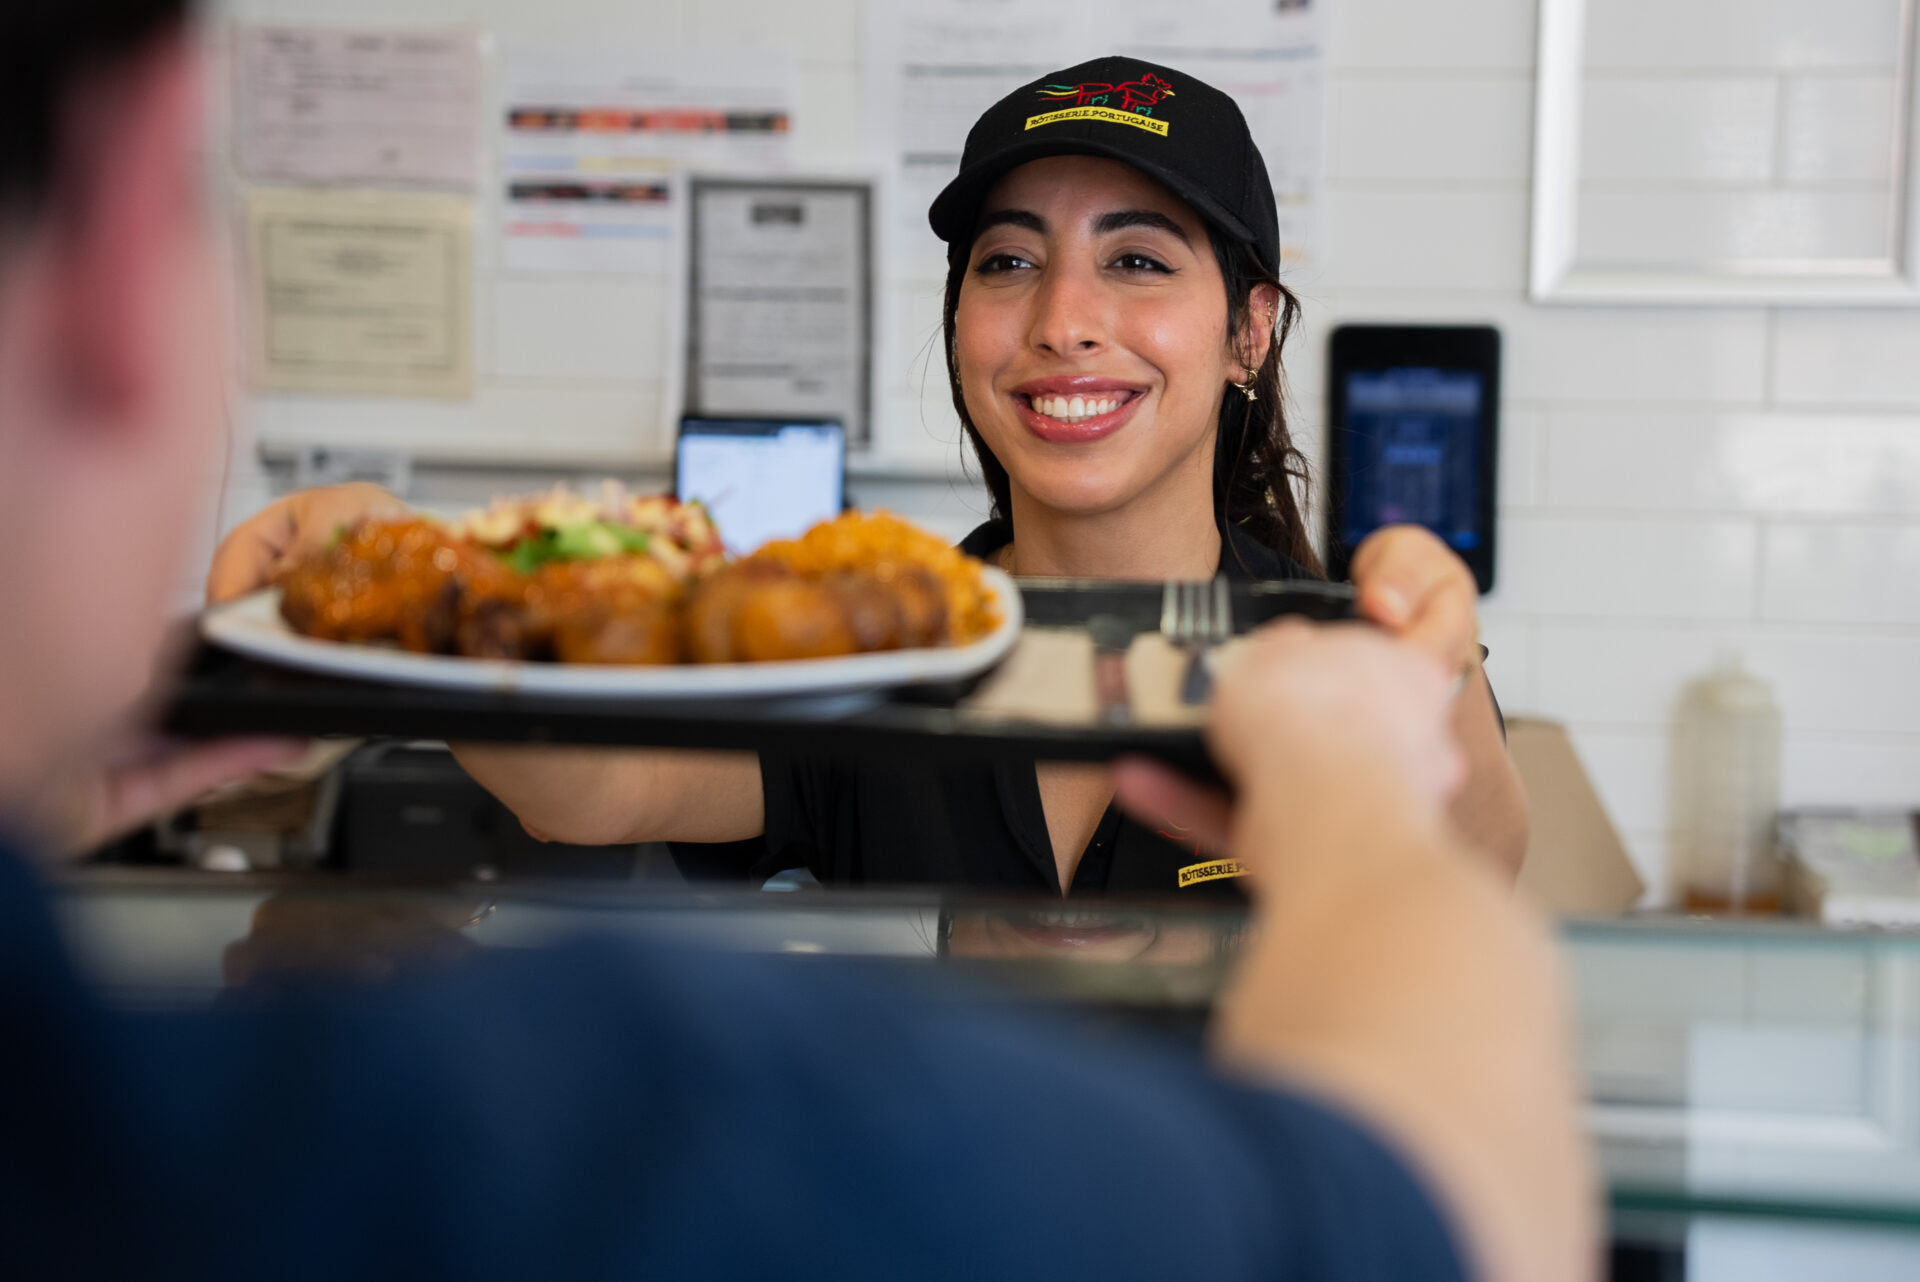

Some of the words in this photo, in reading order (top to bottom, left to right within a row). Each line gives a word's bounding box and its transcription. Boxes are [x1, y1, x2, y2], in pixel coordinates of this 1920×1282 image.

[1030, 109, 1089, 127] RÔTISSERIE
[1091, 110, 1164, 132] PORTUGAISE
[1181, 863, 1235, 883] RÔTISSERIE
